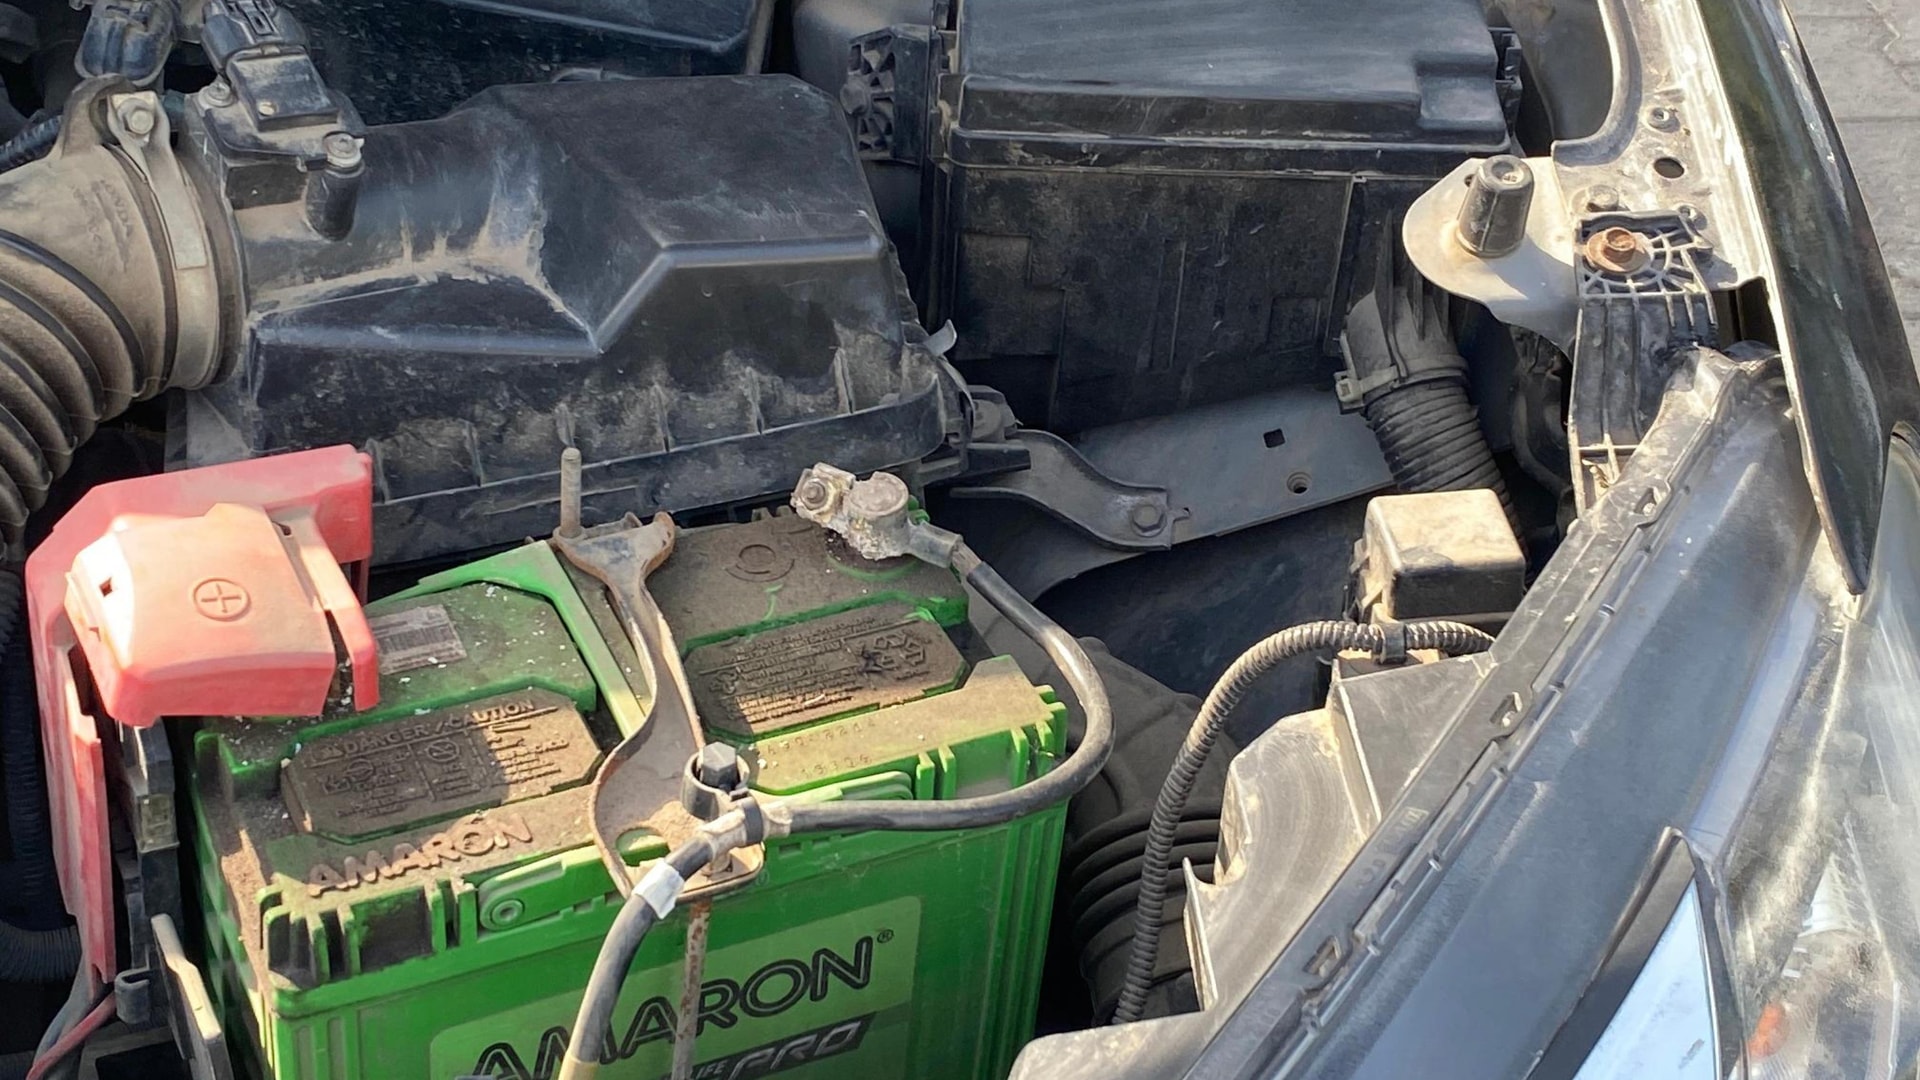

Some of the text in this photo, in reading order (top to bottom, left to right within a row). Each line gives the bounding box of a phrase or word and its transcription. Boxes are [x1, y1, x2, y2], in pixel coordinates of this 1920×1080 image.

[348, 724, 429, 752] DANGER
[451, 699, 536, 728] CAUTION
[307, 811, 533, 897] AMARON
